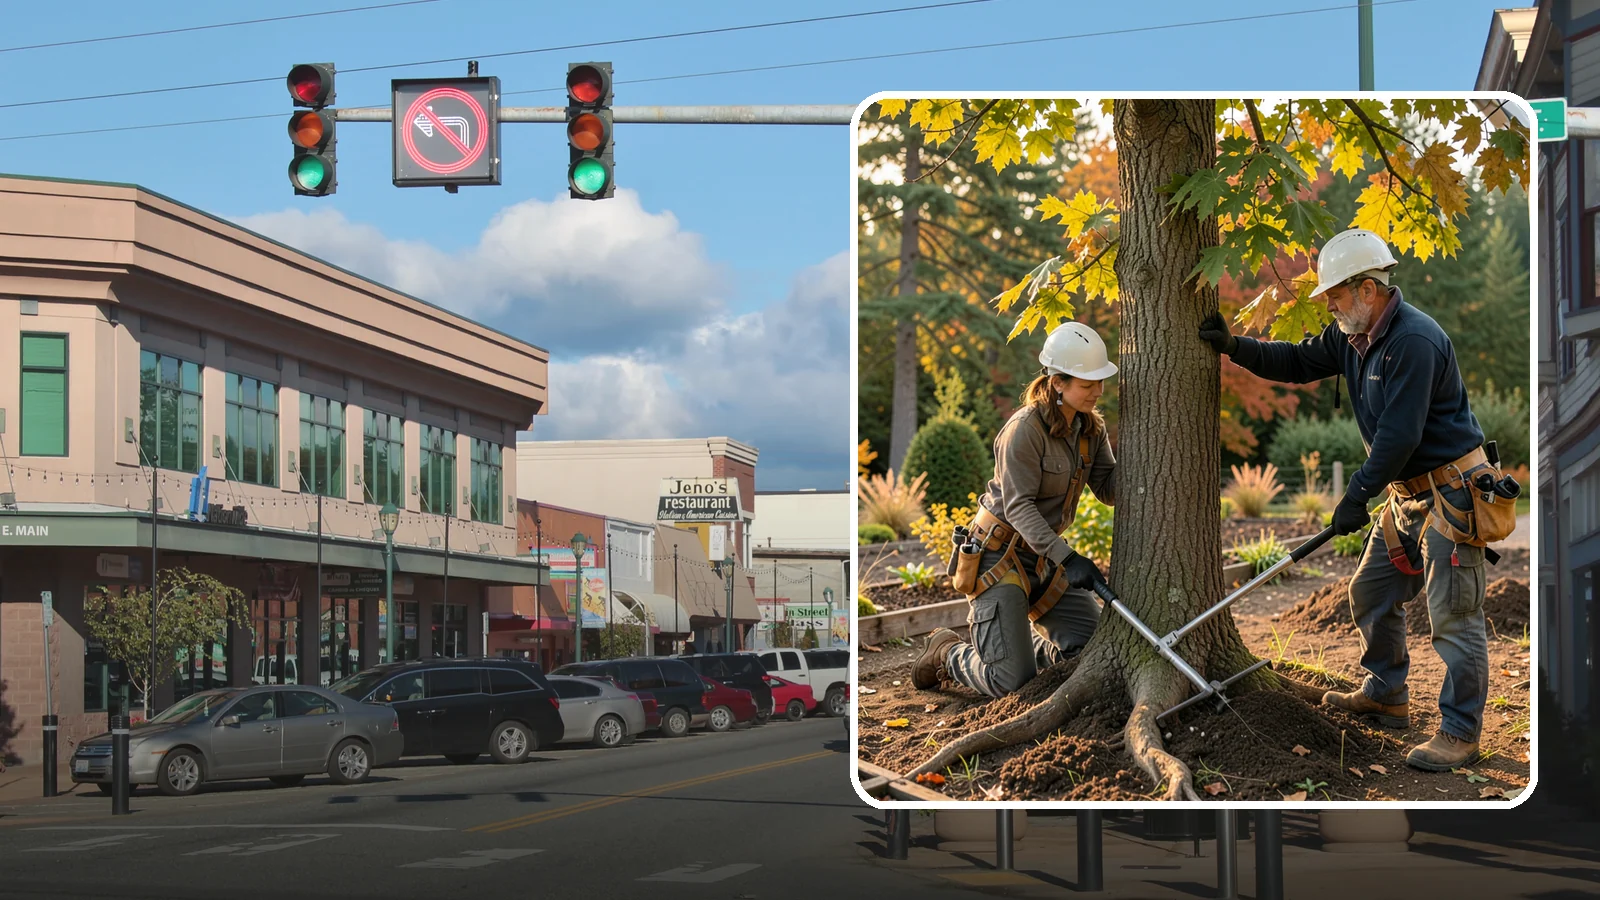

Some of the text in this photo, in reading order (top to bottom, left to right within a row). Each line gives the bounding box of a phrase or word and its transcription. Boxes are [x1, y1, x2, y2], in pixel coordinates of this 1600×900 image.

[669, 480, 727, 494] Jeno's
[665, 496, 731, 509] restaurant
[658, 510, 682, 520] Italian
[685, 509, 715, 519] American
[714, 509, 738, 519] Cuisine
[2, 525, 49, 536] E. MAIN
[797, 607, 828, 617] Street
[791, 619, 823, 627] lass
